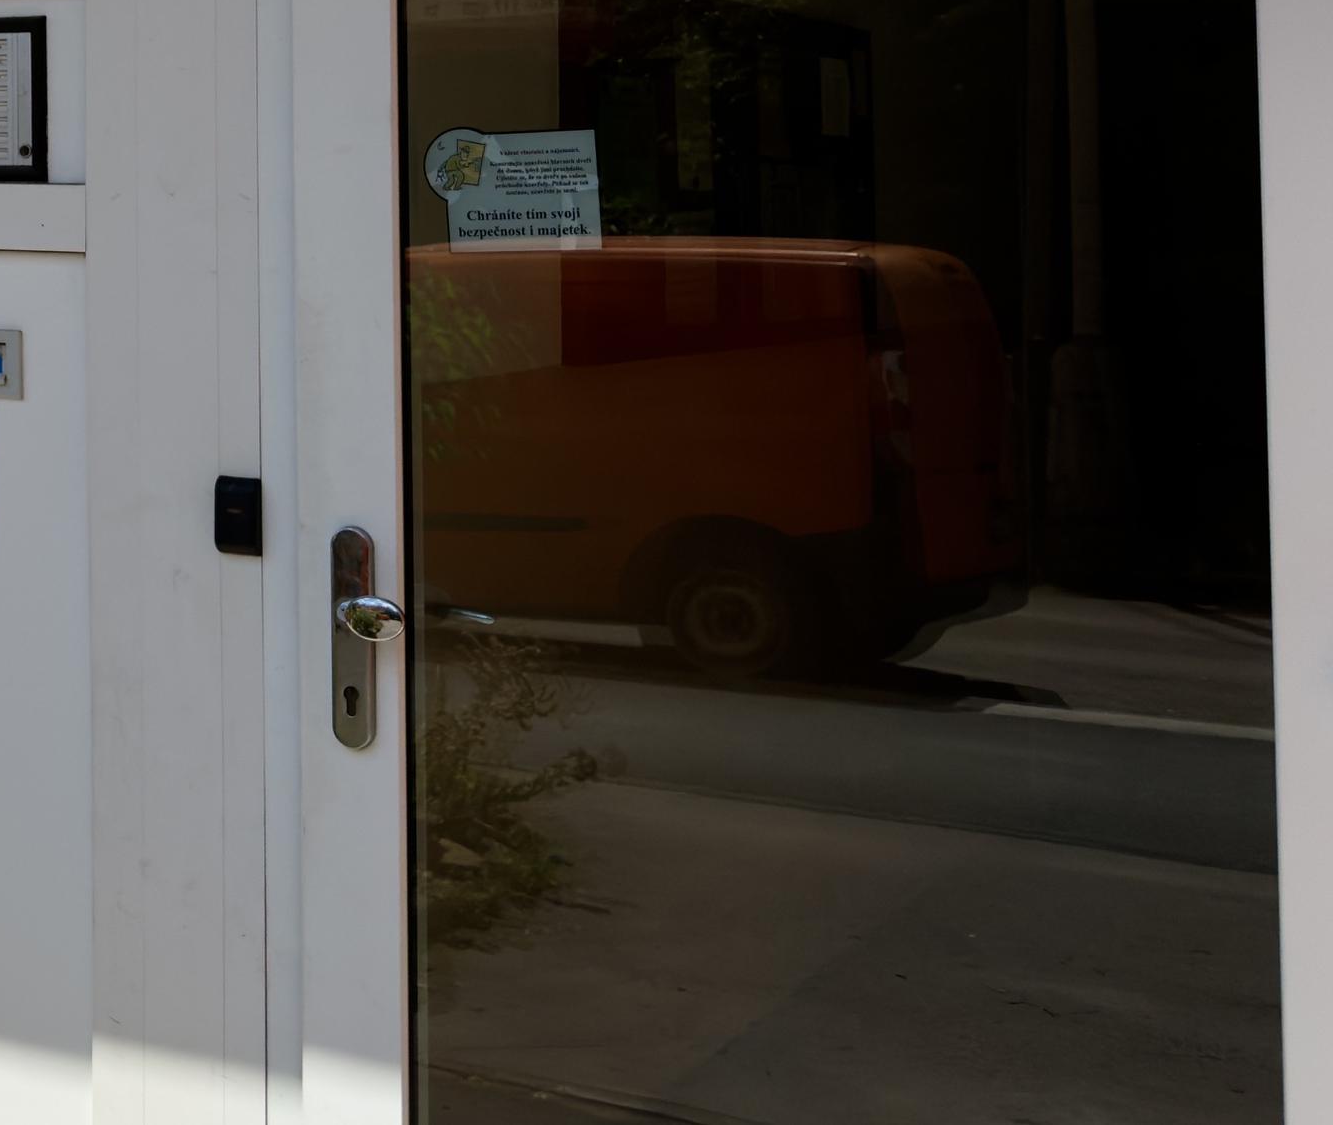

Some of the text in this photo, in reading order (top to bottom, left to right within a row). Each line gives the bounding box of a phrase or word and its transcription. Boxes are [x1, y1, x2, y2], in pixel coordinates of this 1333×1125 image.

[466, 207, 581, 221] Chráníte tím svoji
[458, 223, 591, 240] bezpečnost majetek.
